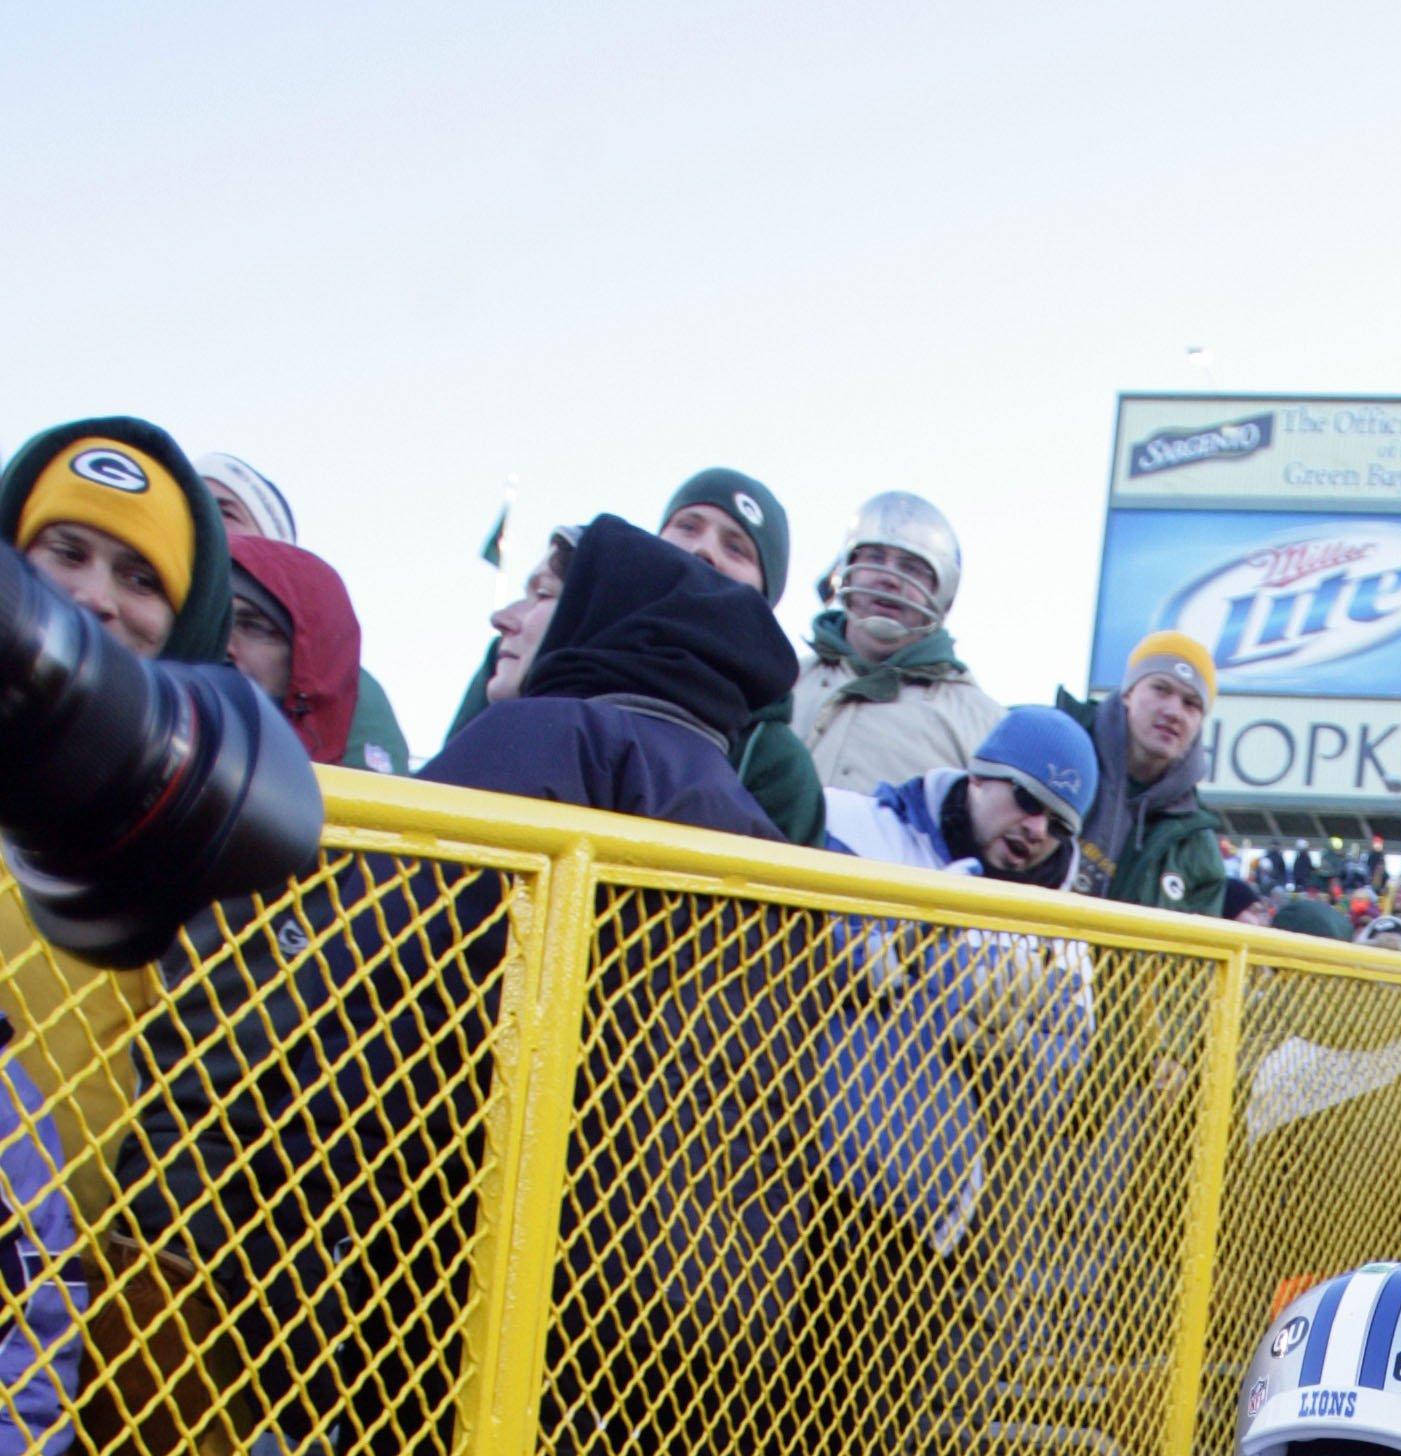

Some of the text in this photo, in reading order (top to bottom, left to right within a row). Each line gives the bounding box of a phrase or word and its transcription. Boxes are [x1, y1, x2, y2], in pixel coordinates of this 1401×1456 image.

[1281, 405, 1327, 434] The
[1377, 439, 1398, 459] of
[1283, 461, 1360, 487] Green
[1251, 541, 1377, 588] Miller
[1298, 1390, 1358, 1419] LIONS
